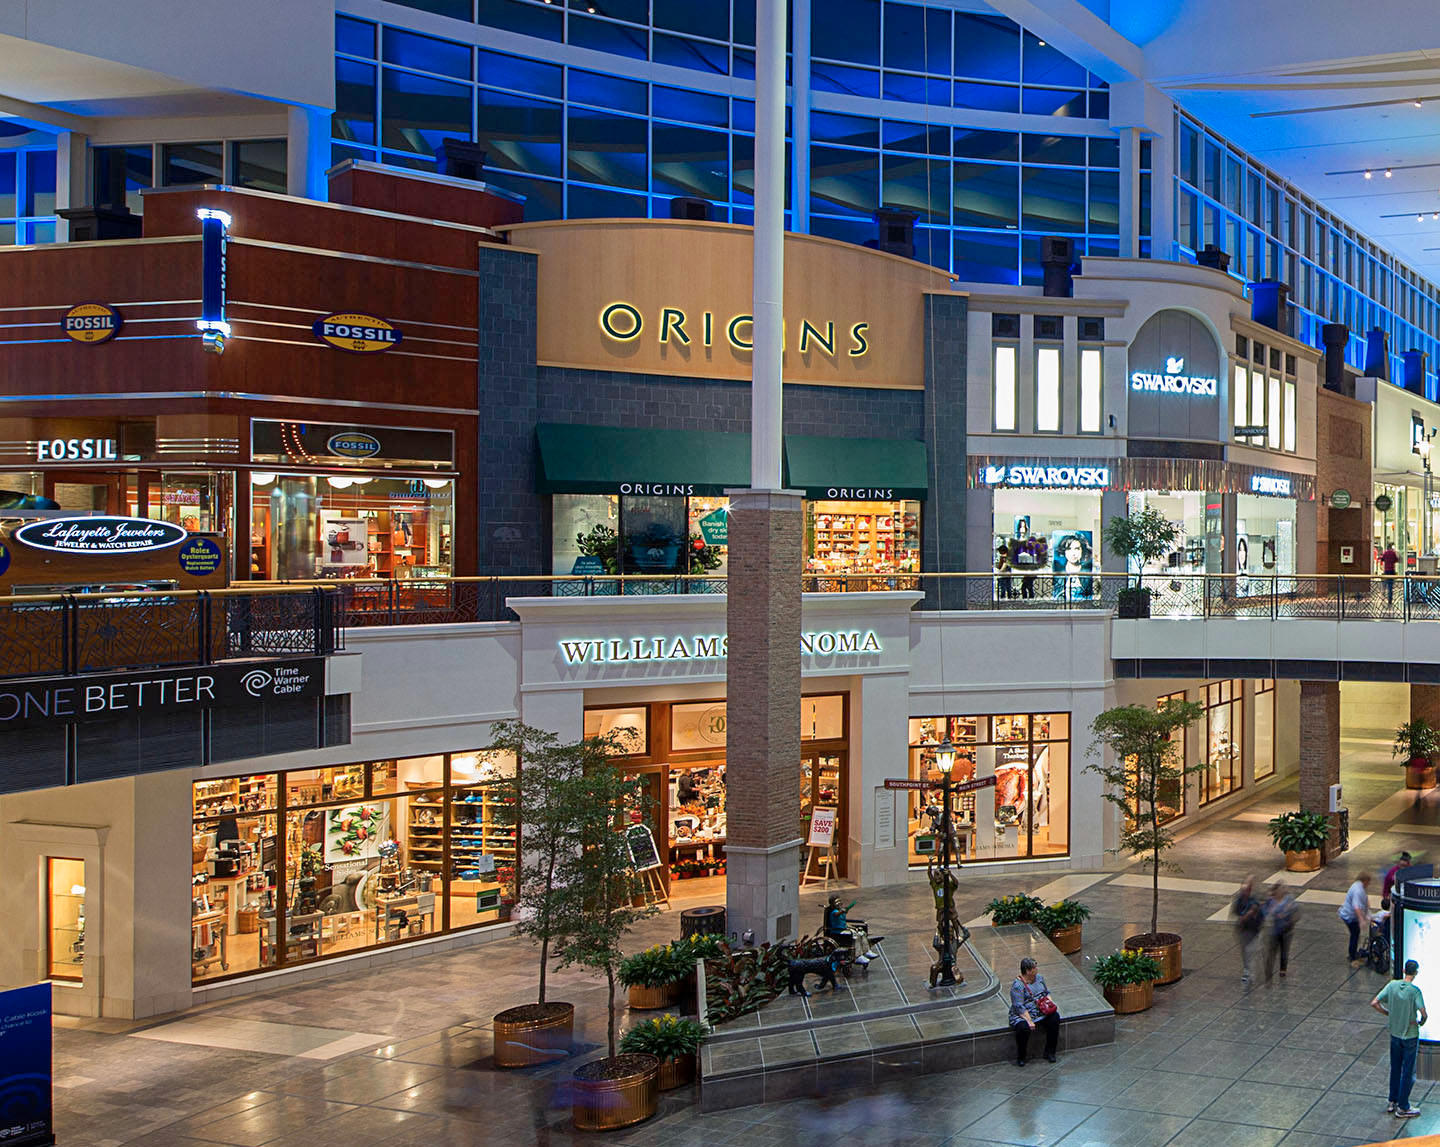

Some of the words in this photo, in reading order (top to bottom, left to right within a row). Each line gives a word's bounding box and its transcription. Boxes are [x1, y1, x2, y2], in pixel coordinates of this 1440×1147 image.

[66, 316, 114, 329] FOSSIL
[601, 302, 870, 356] ORIGNS
[323, 323, 397, 341] FOSSIL
[1132, 373, 1217, 395] SWAROVSKI
[37, 438, 117, 460] FOSSIL
[335, 441, 376, 450] FOSSIL
[1009, 466, 1109, 486] SWAROVSKI
[620, 483, 694, 496] ORIGINS
[827, 488, 893, 499] ORIGINS
[42, 523, 111, 542] Lafayette
[107, 522, 165, 542] Jewelers
[55, 540, 90, 549] JEWELRY
[91, 541, 98, 549] &
[99, 541, 126, 549] WATCH
[127, 540, 154, 548] REPAIR
[801, 632, 880, 653] NOMA
[274, 668, 299, 676] Time
[274, 675, 310, 685] Warner
[274, 684, 302, 695] Cable
[0, 688, 75, 721] ONE
[85, 675, 216, 713] BETTER
[324, 858, 368, 872] Sensational
